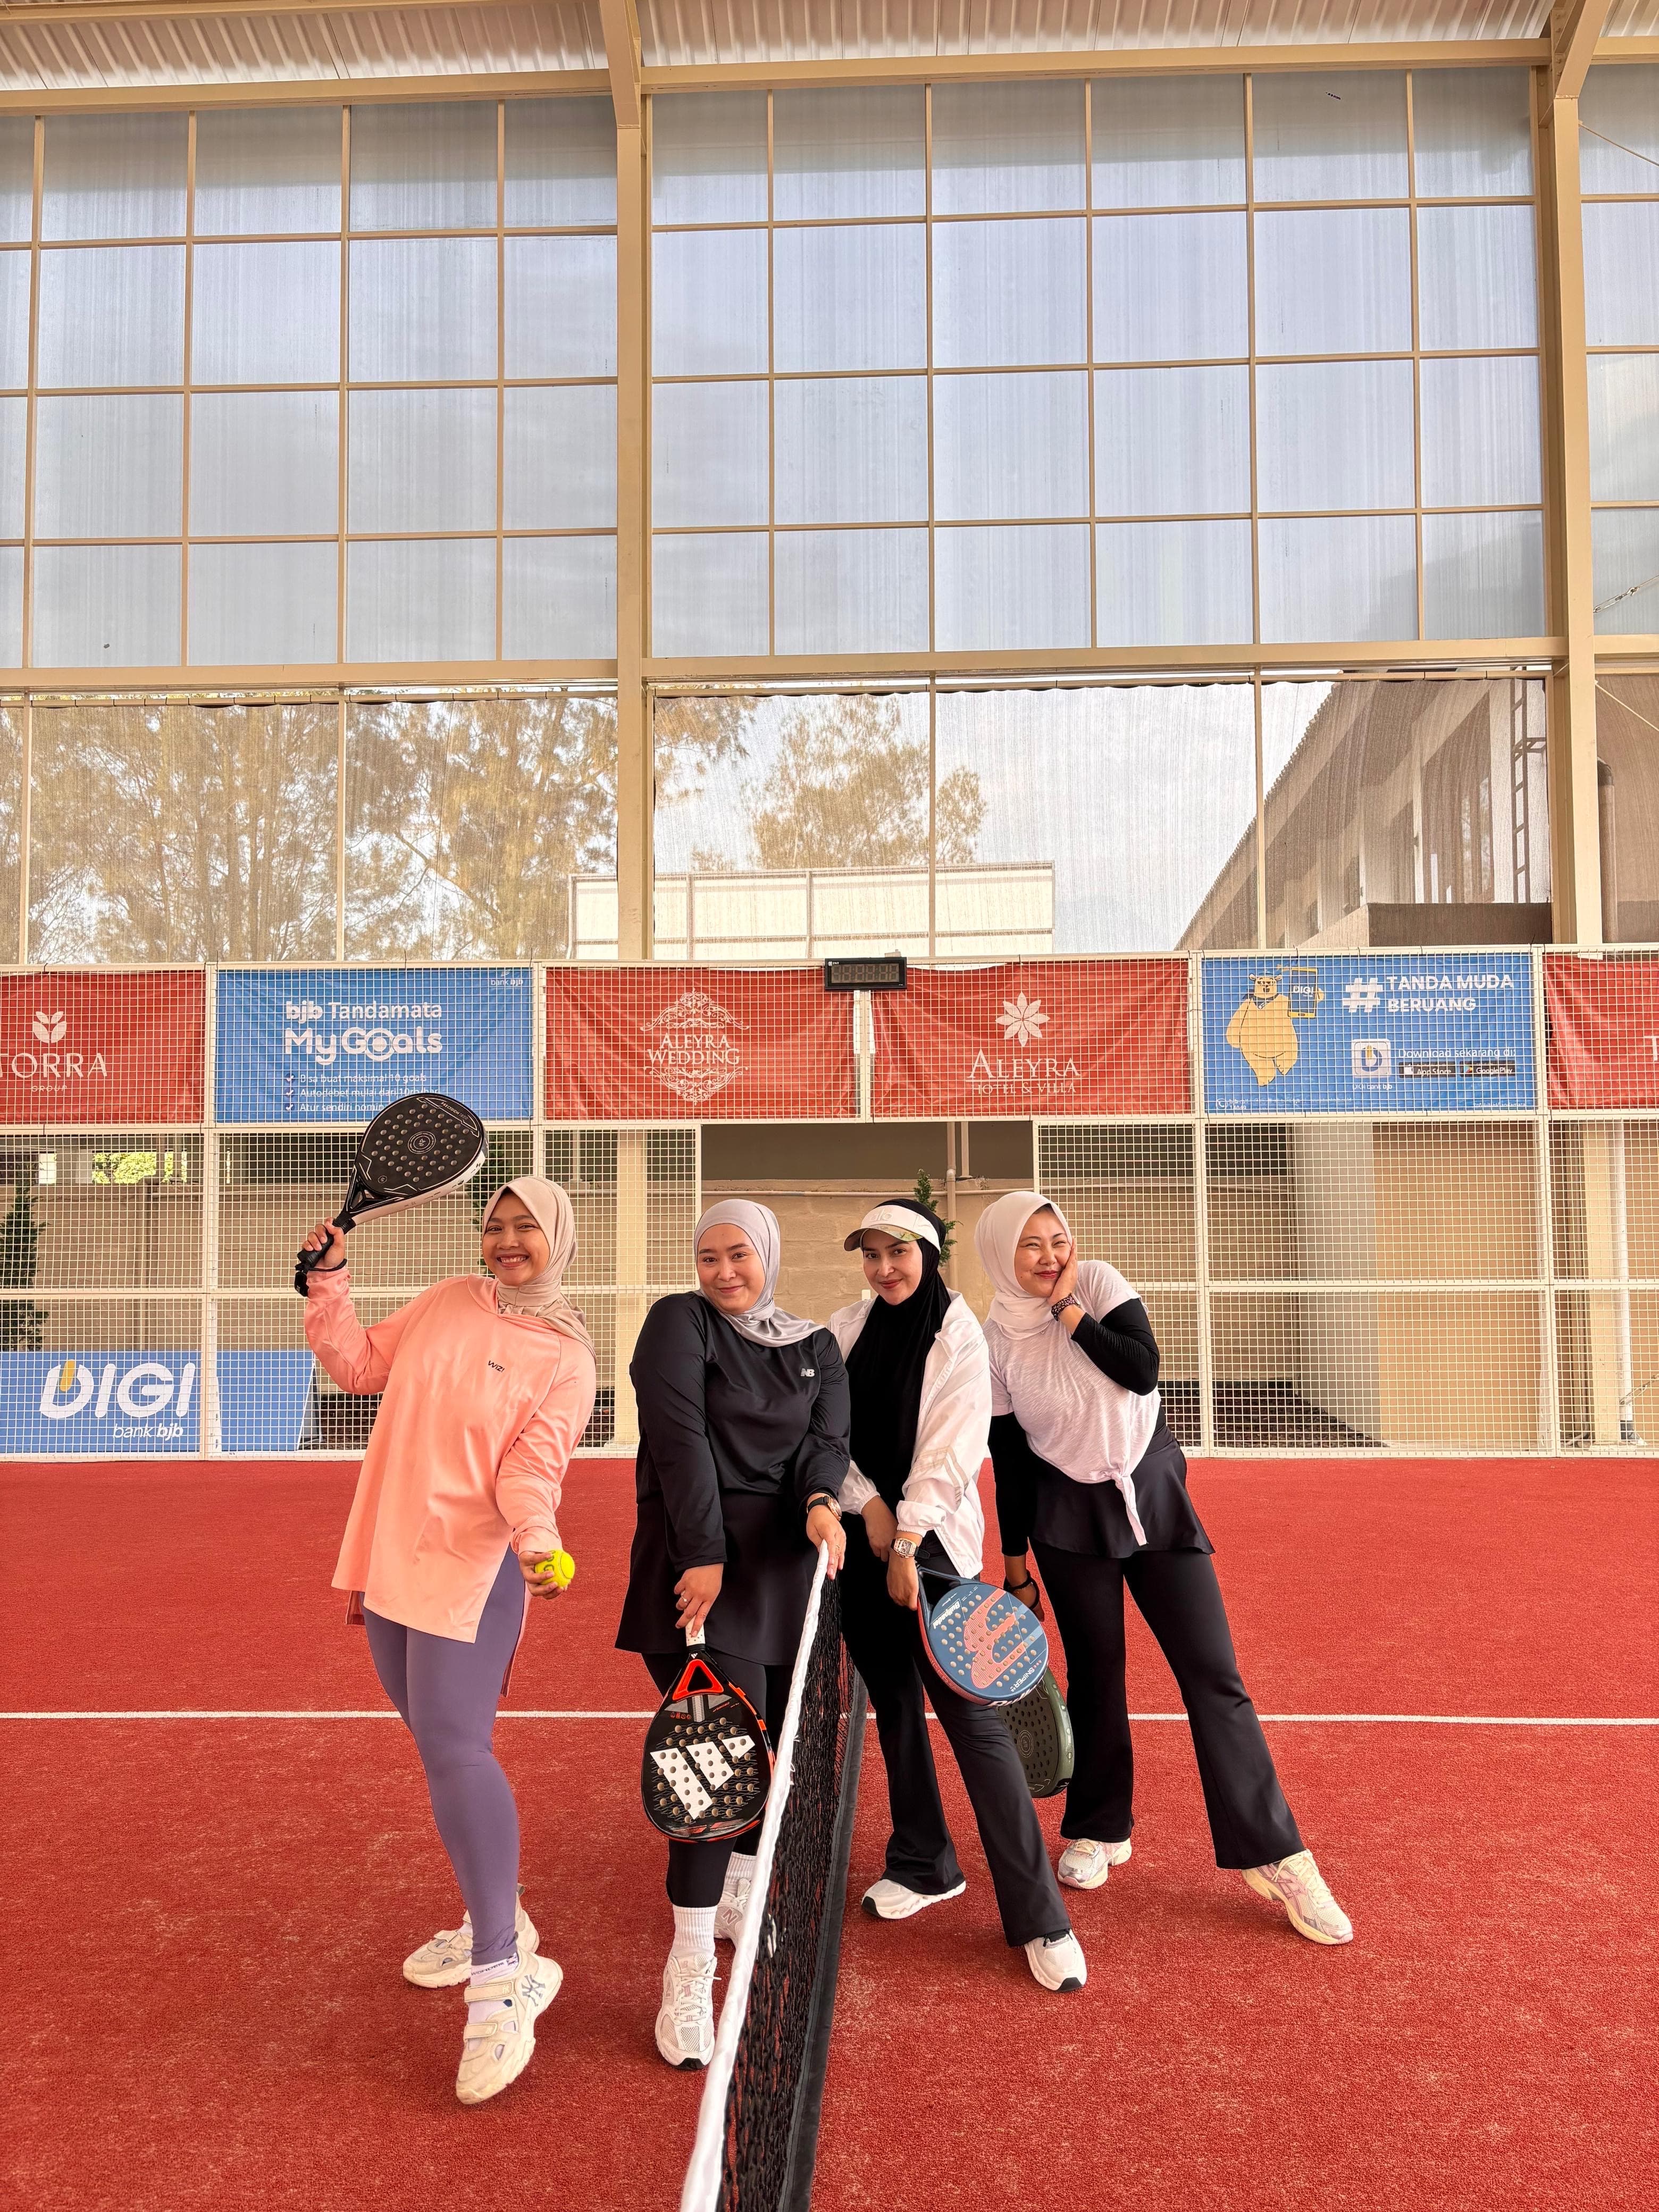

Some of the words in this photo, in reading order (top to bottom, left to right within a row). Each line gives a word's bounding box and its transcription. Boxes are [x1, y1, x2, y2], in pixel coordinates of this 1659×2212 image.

[1386, 975, 1453, 990] TANDA
[1457, 974, 1514, 989] MUDA
[286, 1000, 323, 1024] bjb
[328, 1000, 442, 1019] Tandamata
[1388, 998, 1477, 1012] BERUANG
[659, 1032, 731, 1049] ALEYRA
[647, 1048, 740, 1065] WEDDING
[1398, 1049, 1452, 1058] Download
[1455, 1048, 1499, 1059] sekarang
[966, 1048, 1081, 1078] ALEYRA
[300, 1074, 318, 1083] Bsa
[1417, 1068, 1430, 1077] App
[972, 1083, 1016, 1095] HOTEL
[1021, 1082, 1032, 1094] &
[1037, 1082, 1077, 1094] VILLA
[39, 1359, 196, 1419] DIGI
[112, 1423, 152, 1439] bank
[156, 1422, 184, 1442] bjb
[1013, 1666, 1036, 1687] SNIPER
